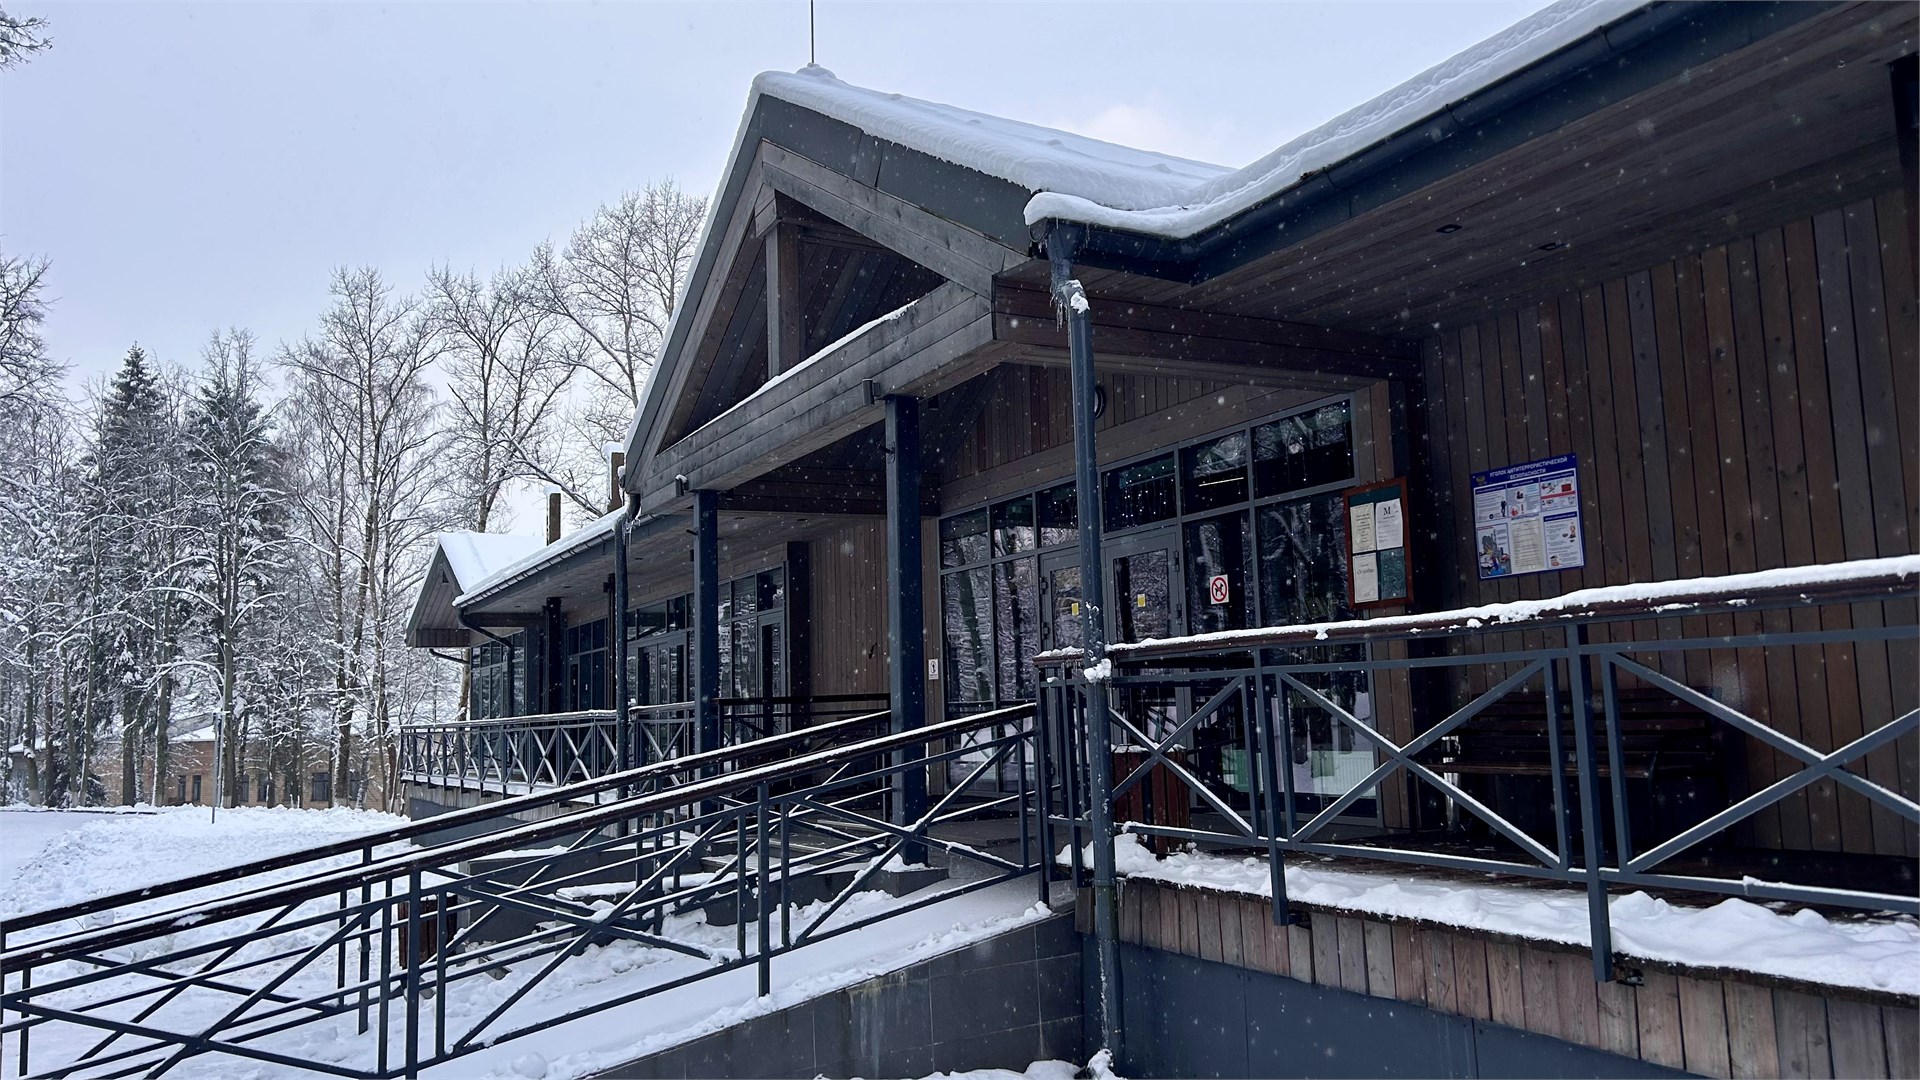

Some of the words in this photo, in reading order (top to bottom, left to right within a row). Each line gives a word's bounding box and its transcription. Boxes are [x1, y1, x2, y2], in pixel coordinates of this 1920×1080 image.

[1489, 468, 1507, 478] УГОЛОК
[1507, 456, 1568, 474] АНТИТЕРРОРИСТИЧЕСКОЙ
[1509, 468, 1546, 480] БЕЗОПАСНОСТИ
